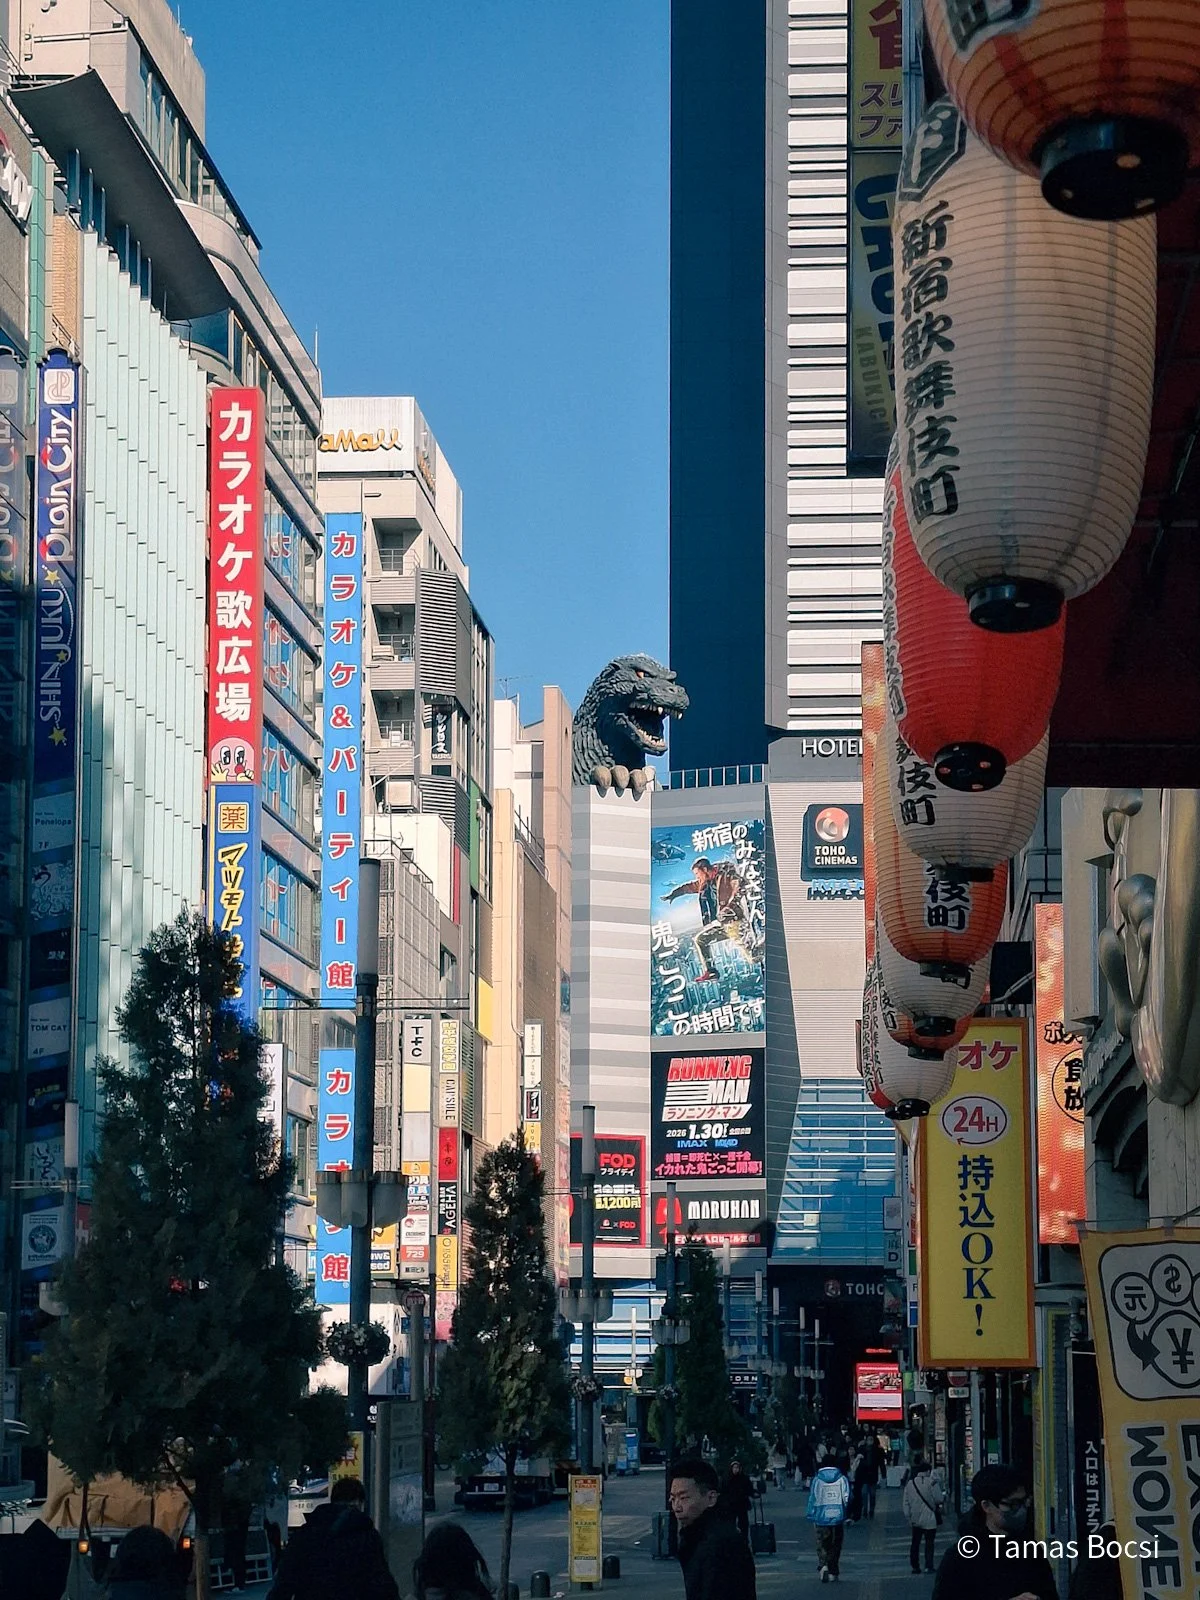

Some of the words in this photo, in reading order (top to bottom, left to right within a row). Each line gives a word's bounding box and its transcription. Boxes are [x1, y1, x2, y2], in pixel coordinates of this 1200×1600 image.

[901, 200, 960, 526] 新宿歌舞伎町
[214, 402, 253, 723] カラオケ歌広場
[40, 588, 71, 722] SHINJUKU
[327, 531, 357, 989] カラオケ&パーティー館
[222, 806, 245, 830] 薬
[814, 845, 846, 856] TOHO
[814, 856, 858, 865] CINEMAS
[925, 862, 971, 929] 伎町
[667, 1055, 753, 1082] RUNNING
[706, 1080, 750, 1105] MAN
[666, 1105, 743, 1120] ランニング・マン
[953, 1106, 998, 1132] 24H
[666, 1129, 687, 1138] 2026
[688, 1123, 724, 1140] 1.30
[677, 1140, 708, 1149] IMAX
[598, 1153, 636, 1169] FOD
[654, 1160, 763, 1176] イカれた鬼ごっこ開幕!
[321, 1067, 352, 1282] カラ館
[445, 1185, 456, 1228] AGEHA
[688, 1199, 760, 1220] MARUHAN
[405, 1250, 425, 1258] 729
[957, 1154, 996, 1337] 持込OK!
